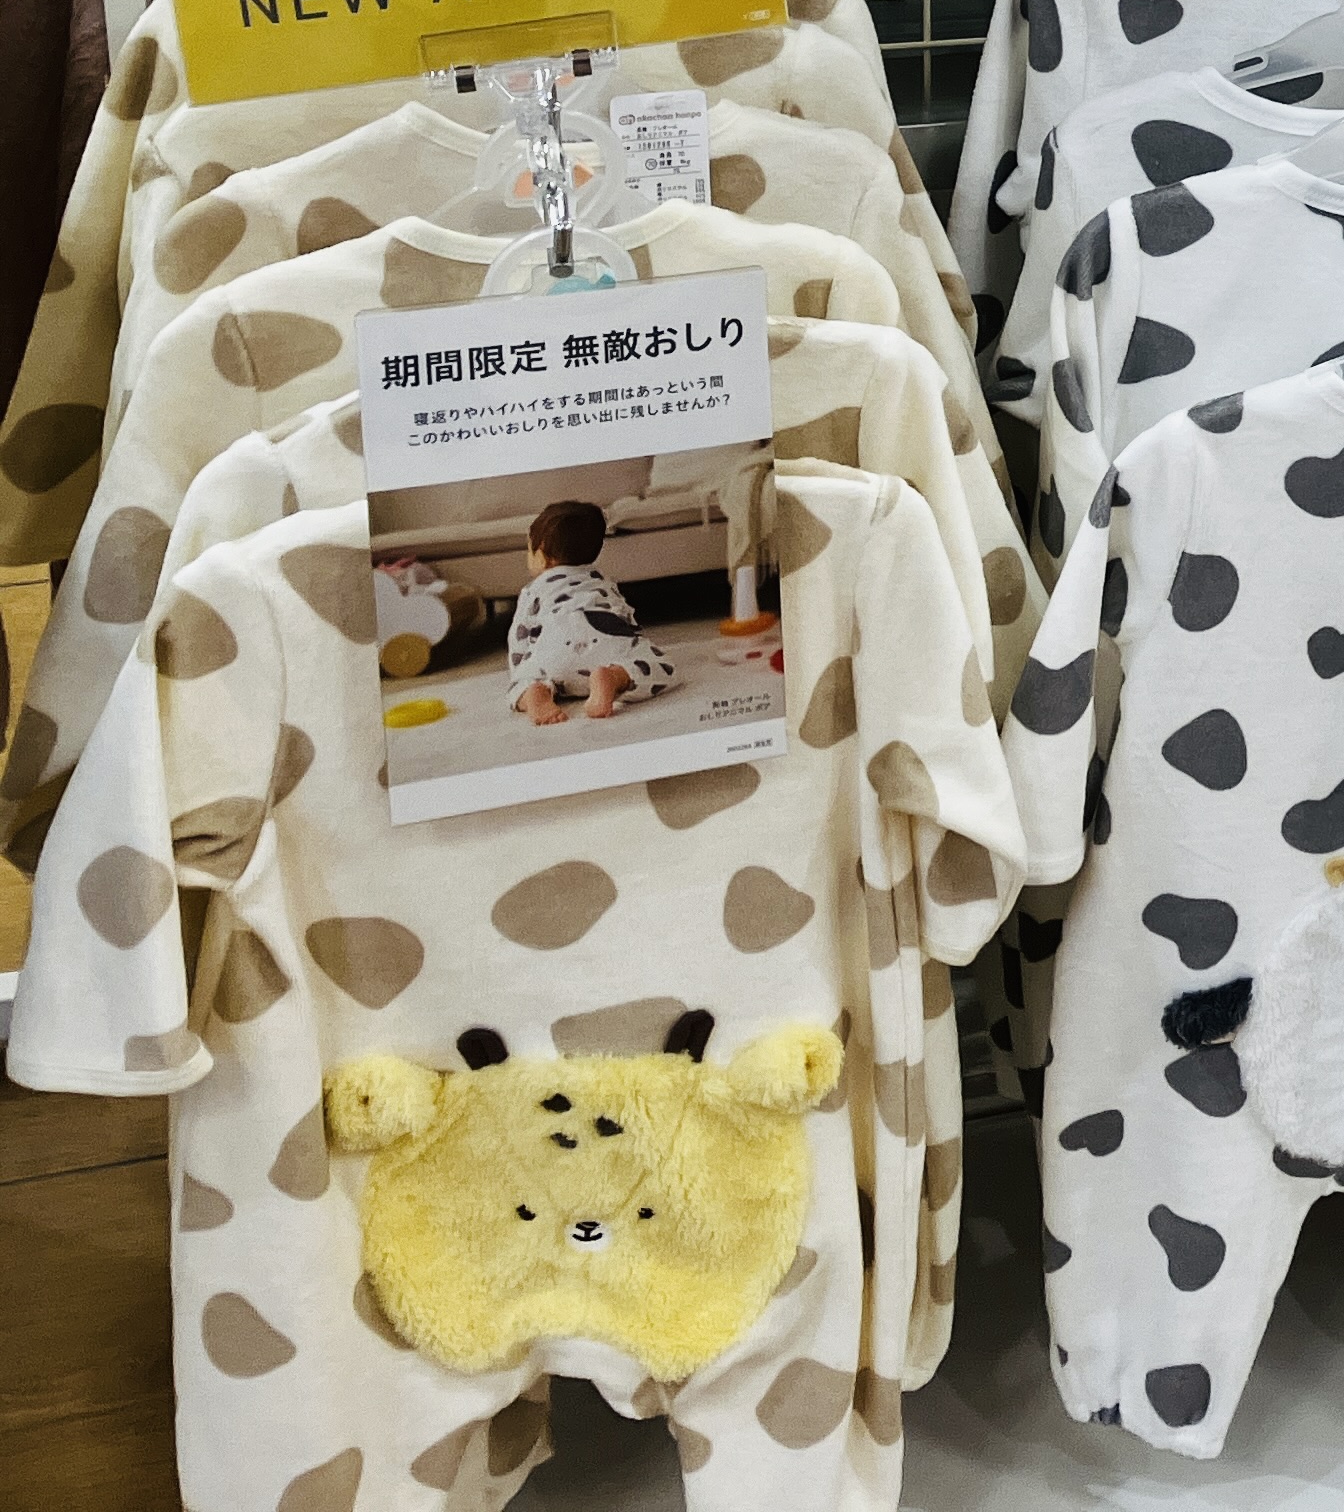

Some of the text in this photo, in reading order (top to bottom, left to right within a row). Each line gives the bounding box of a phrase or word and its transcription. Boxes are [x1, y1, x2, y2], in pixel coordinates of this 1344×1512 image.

[381, 317, 744, 389] 期間限定 無敵おしり
[408, 393, 731, 447] このかわいいおしりを思い出に残しませんか?
[413, 375, 724, 427] 寝返りやハイハイをする期間はあっという間
